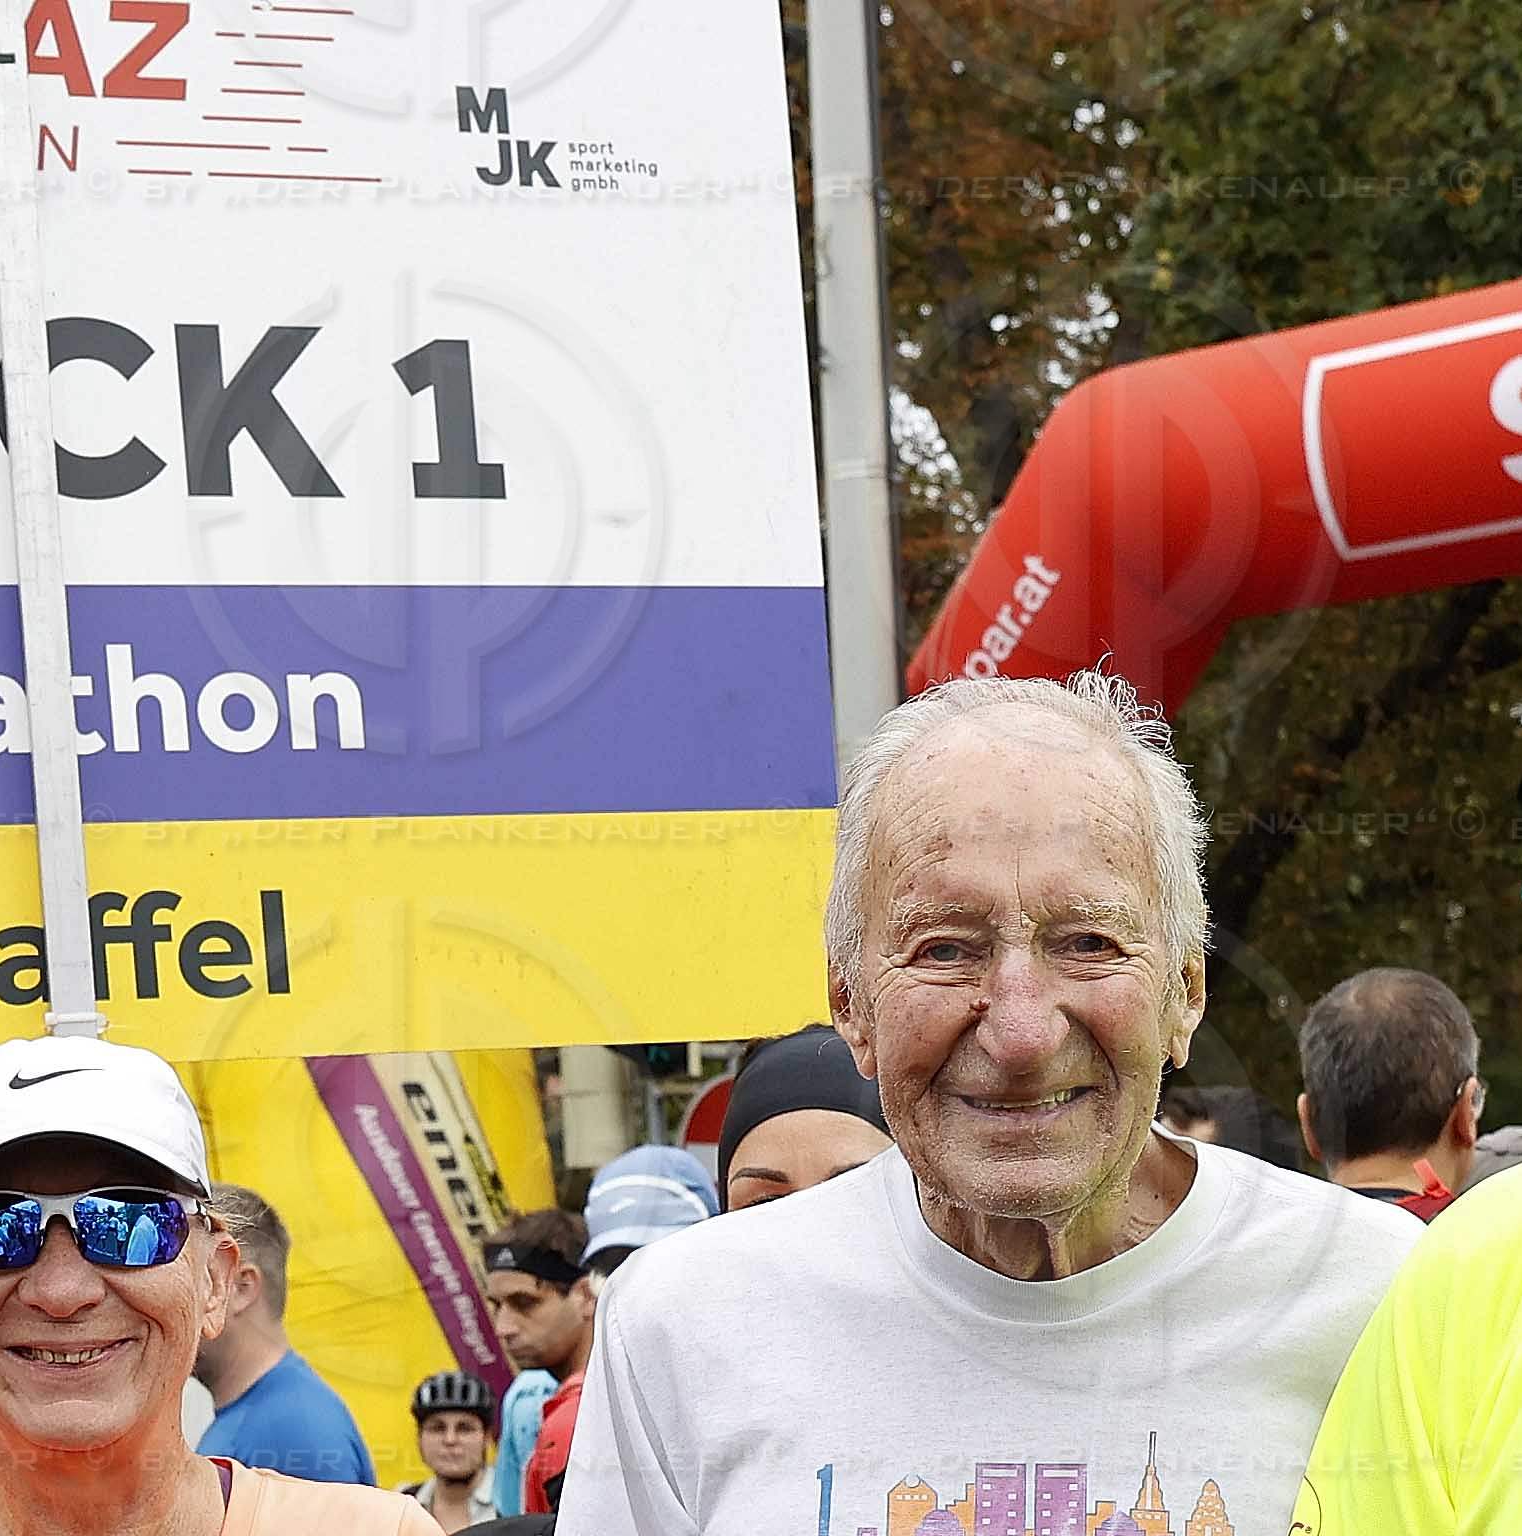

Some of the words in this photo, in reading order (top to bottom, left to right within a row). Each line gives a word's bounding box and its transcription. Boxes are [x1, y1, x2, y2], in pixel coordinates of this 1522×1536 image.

[569, 141, 614, 156] sport
[475, 138, 562, 189] JK
[570, 157, 658, 177] marketing
[572, 176, 619, 192] gmbh
[392, 338, 507, 499] 1
